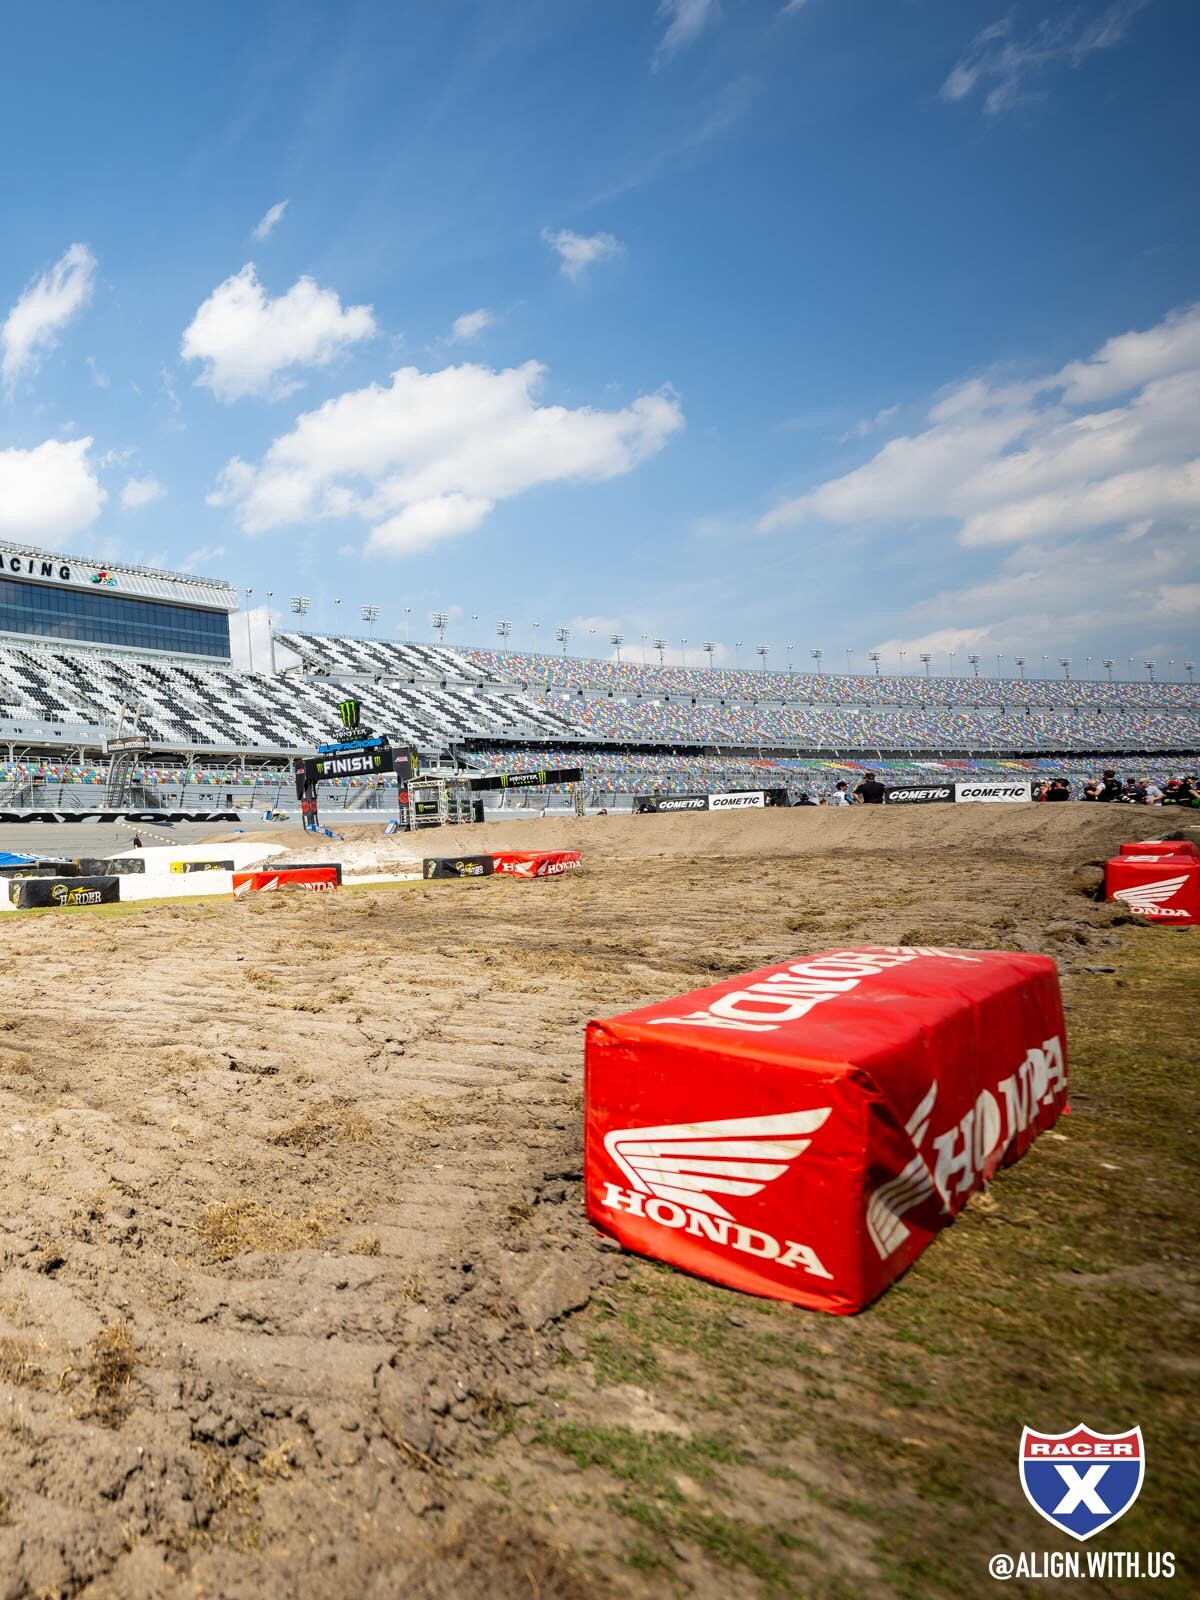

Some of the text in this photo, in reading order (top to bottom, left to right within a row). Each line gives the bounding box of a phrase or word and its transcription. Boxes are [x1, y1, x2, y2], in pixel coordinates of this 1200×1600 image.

[323, 755, 374, 775] FINISH
[509, 773, 539, 783] MONSTER
[888, 787, 951, 801] COMETIC
[960, 787, 1026, 798] COMETIC
[658, 798, 705, 810] COMETIC
[712, 796, 760, 807] COMETIC
[547, 860, 582, 875] HONDA
[60, 891, 102, 906] HARDER
[1130, 906, 1192, 917] ONDA
[647, 949, 919, 1032] HONDA
[932, 1035, 1068, 1214] HONDA
[600, 1181, 834, 1280] HONDA
